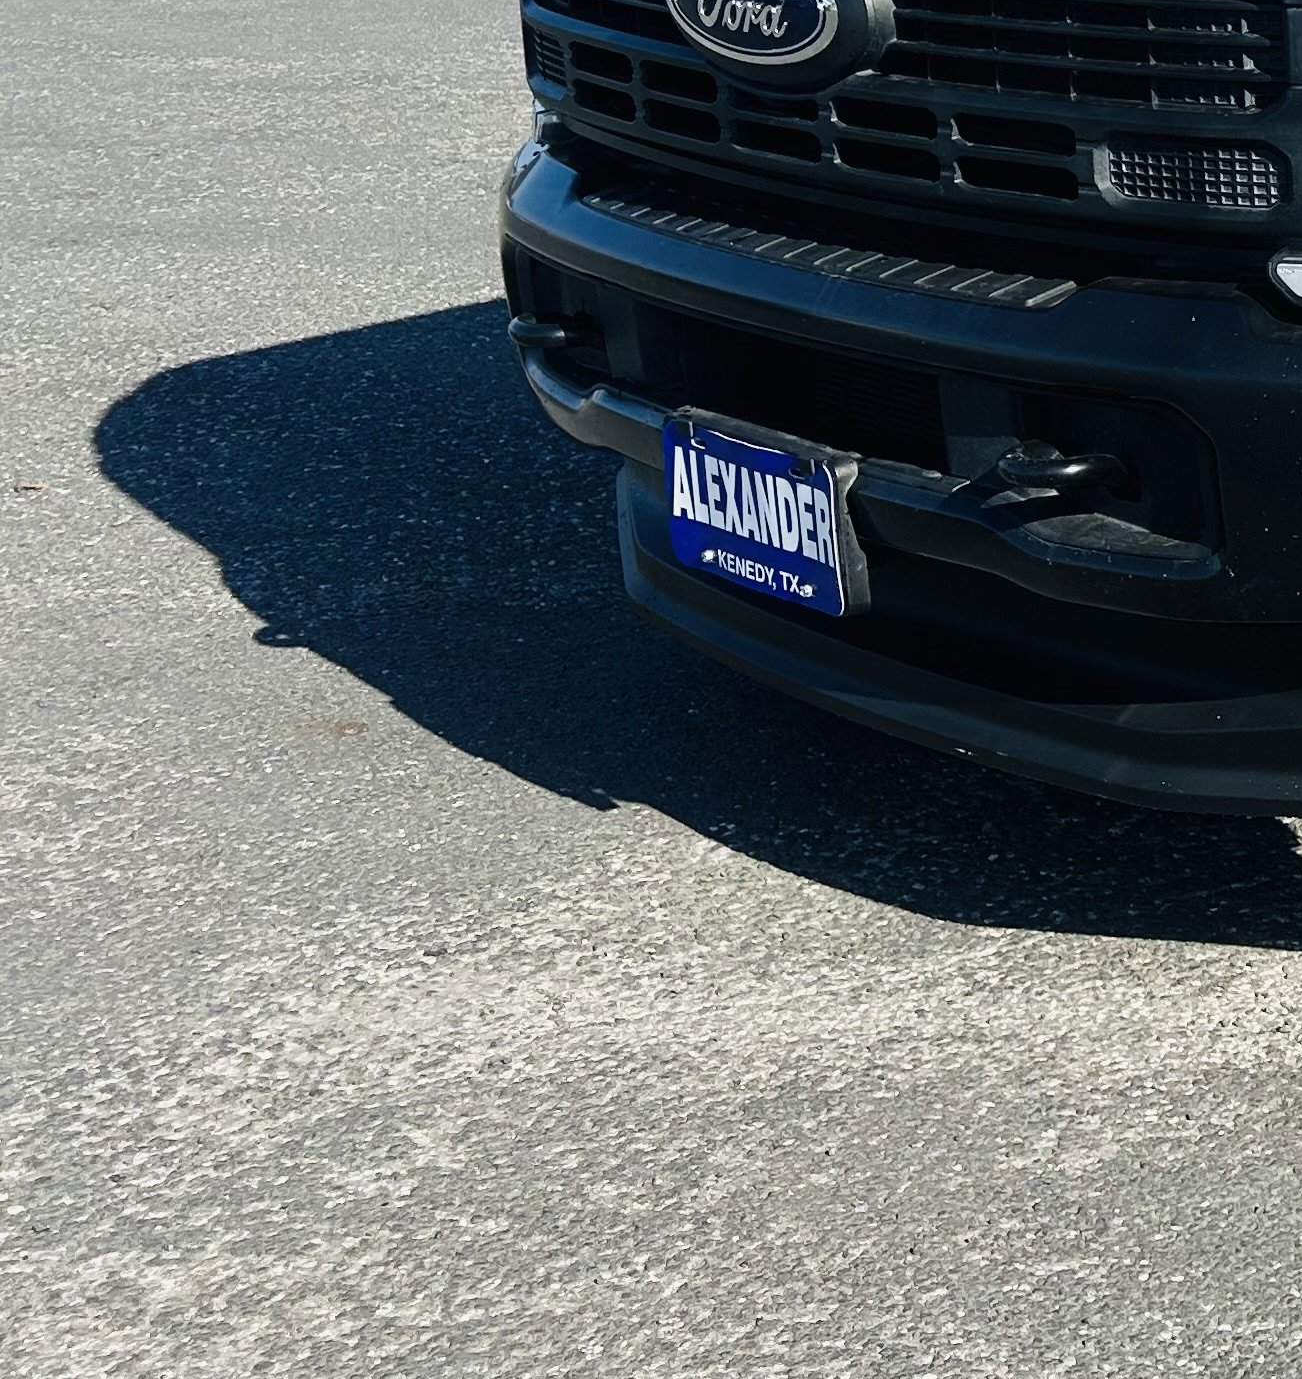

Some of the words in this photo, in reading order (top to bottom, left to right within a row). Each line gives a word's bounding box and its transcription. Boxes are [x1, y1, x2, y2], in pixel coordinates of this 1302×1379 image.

[673, 445, 835, 568] ALEXANDER
[717, 548, 777, 591] KENEDY,
[779, 571, 800, 594] TX
